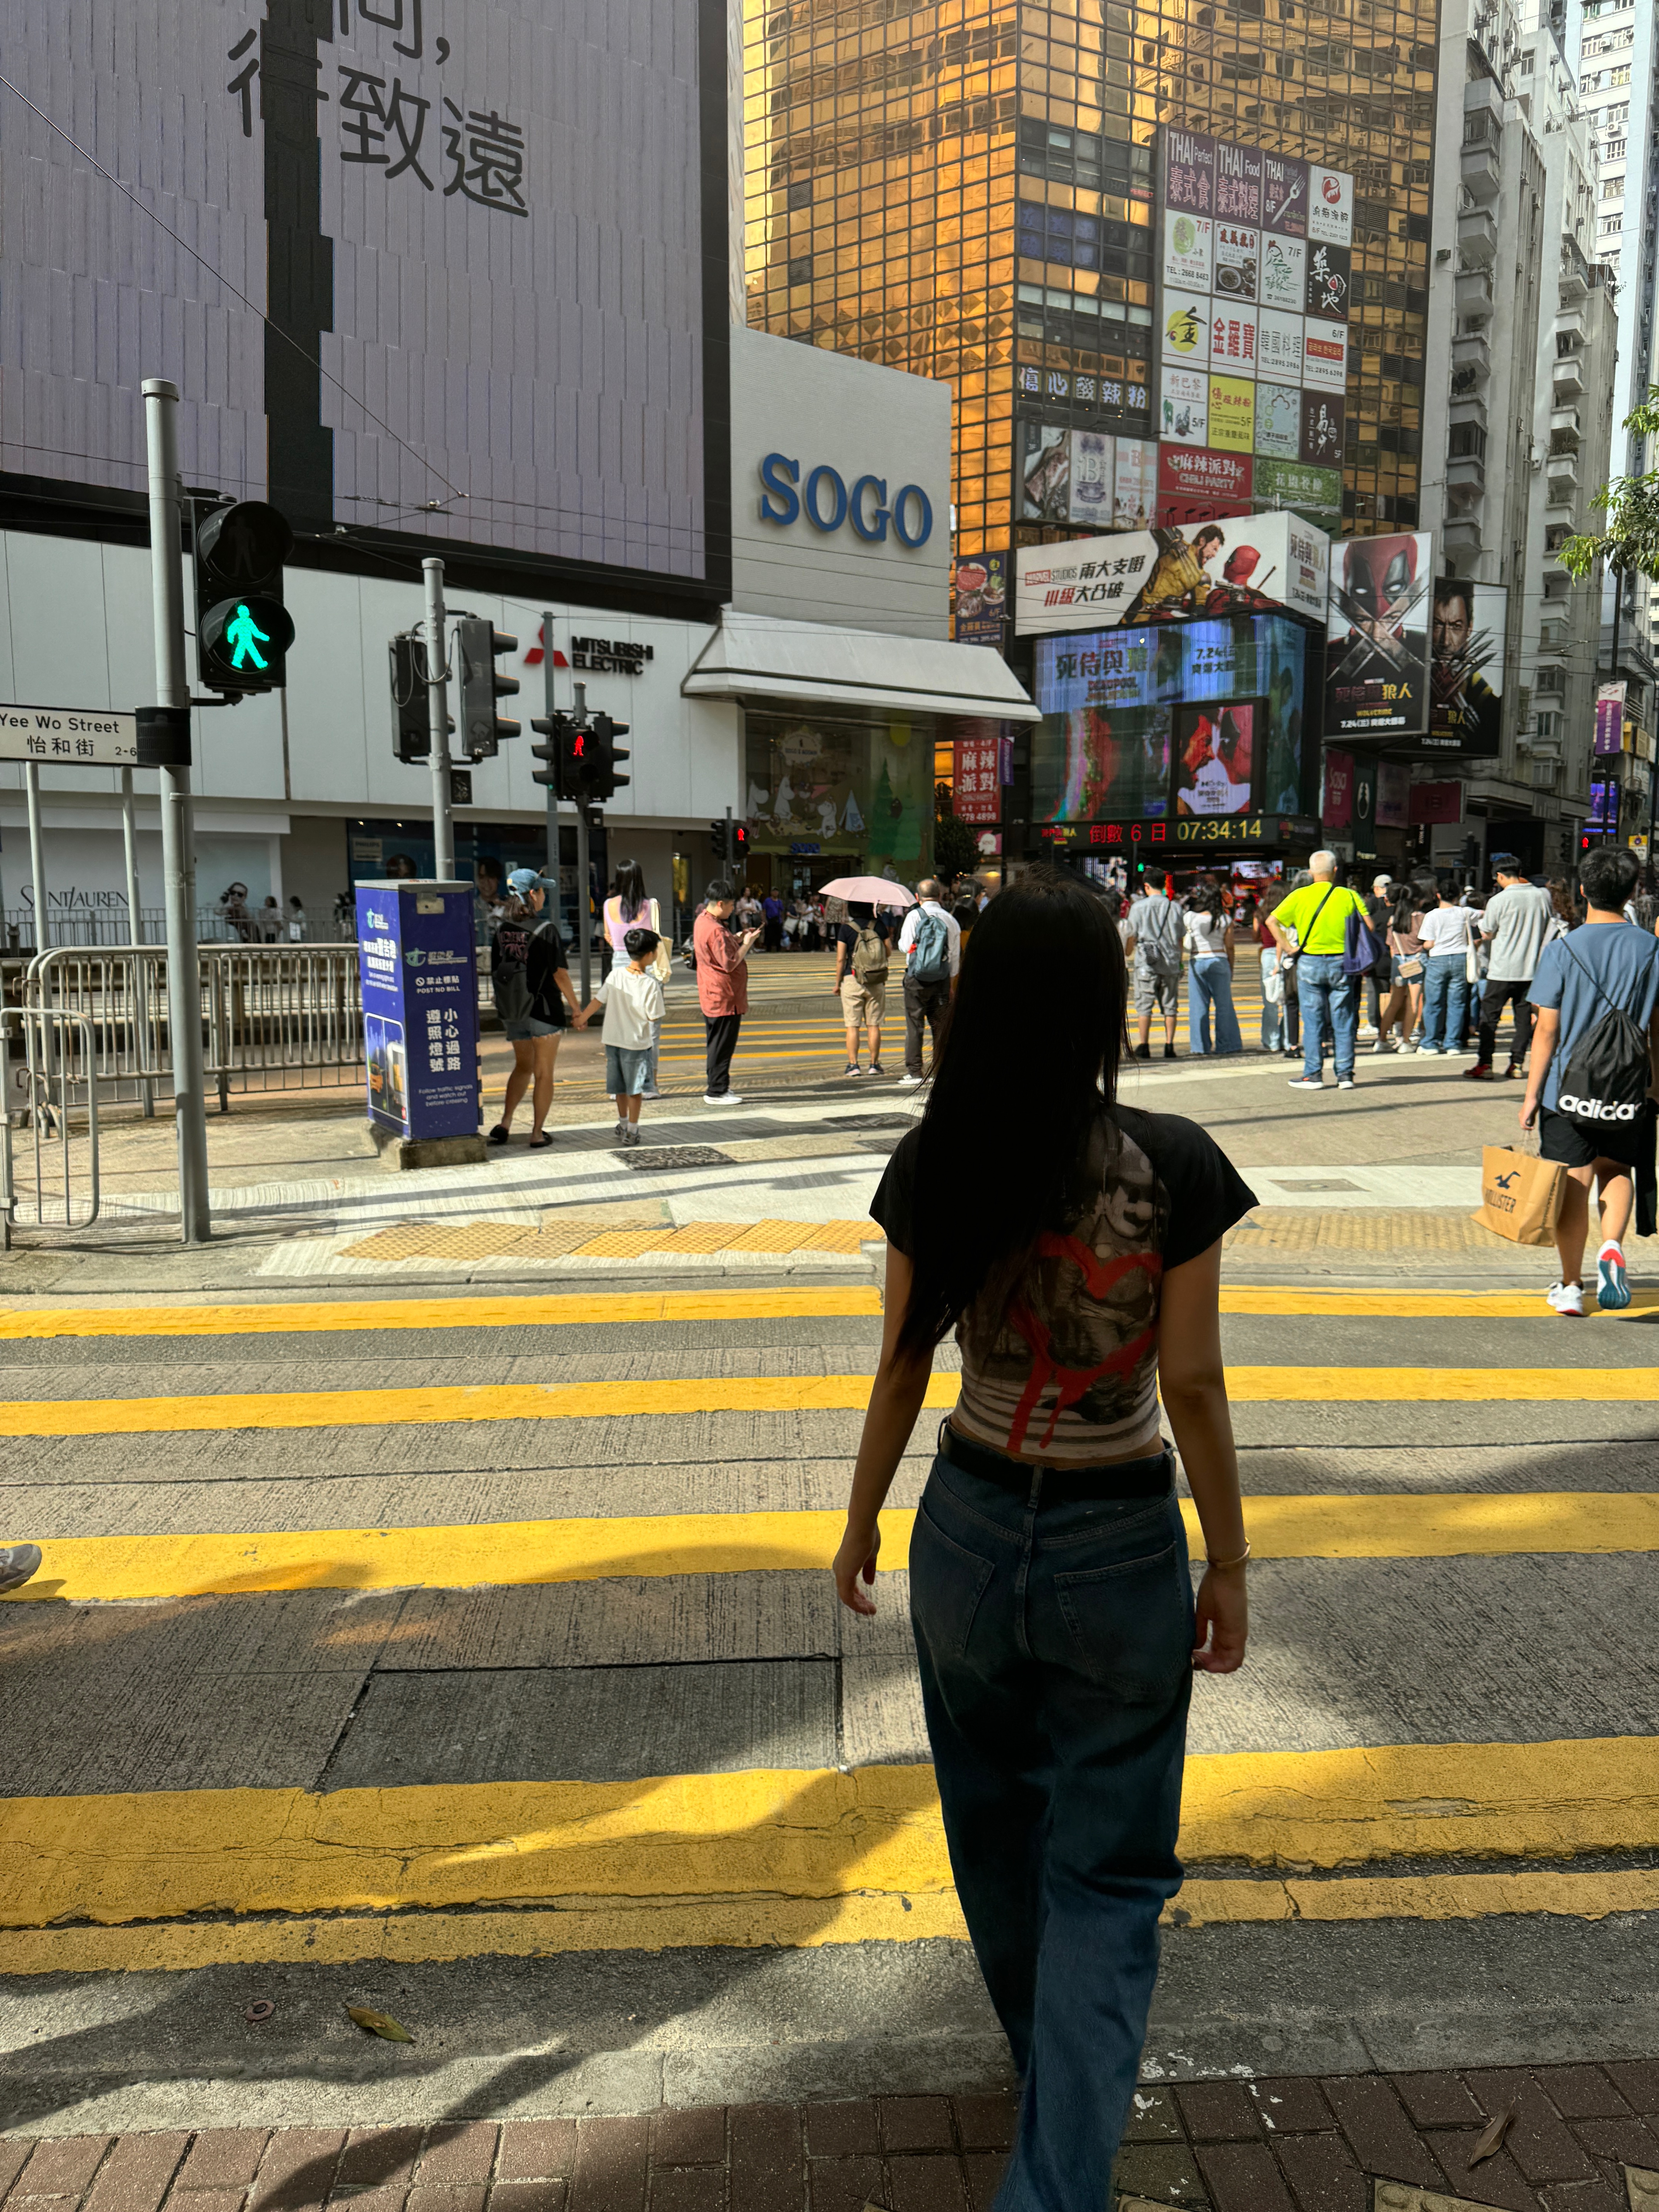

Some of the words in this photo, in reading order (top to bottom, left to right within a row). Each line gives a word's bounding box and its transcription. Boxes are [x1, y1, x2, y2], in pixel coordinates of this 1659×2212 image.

[1170, 131, 1194, 165] THAI
[1219, 144, 1243, 178] THAI
[1245, 160, 1260, 177] Food
[1266, 159, 1284, 182] THAI
[1217, 176, 1258, 220] 泰式料理
[1197, 220, 1210, 234] 7/F
[1288, 247, 1302, 258] 7/F
[1332, 330, 1344, 338] 6/F
[1174, 453, 1236, 477] 麻辣派對
[1205, 476, 1235, 489] PARTY
[760, 452, 933, 548] SOGO
[571, 636, 654, 660] MITSUBISHI
[572, 653, 645, 675] ELECTRIC
[0, 713, 29, 728] Yee
[35, 715, 61, 730] Wo
[69, 718, 120, 734] Street
[27, 735, 95, 757] 怡和街
[962, 750, 995, 771] 麻辣
[962, 771, 995, 792] 派對
[1089, 824, 1123, 844] 倒數
[1130, 824, 1142, 842] 6
[1152, 823, 1166, 842] 日
[1177, 819, 1262, 840] 07:34:14
[791, 842, 821, 854] SOGO
[18, 884, 70, 911] SNT
[69, 886, 129, 910] LAUREN
[426, 1009, 444, 1072] 遵照燈號
[444, 1008, 461, 1071] 小心過路
[1559, 1094, 1642, 1121] adida
